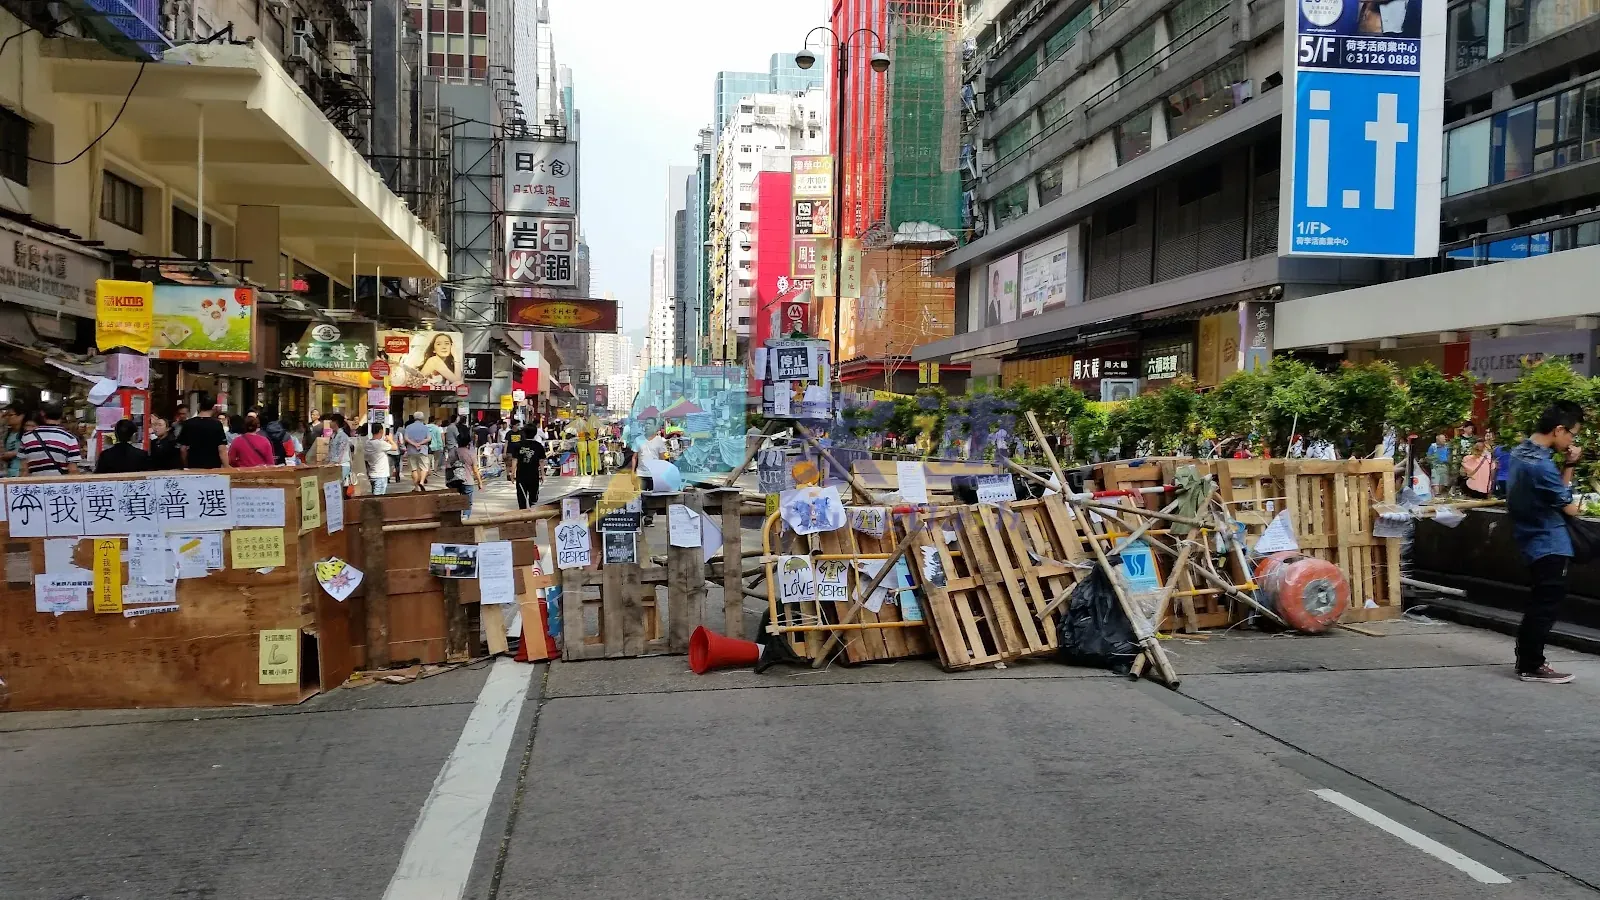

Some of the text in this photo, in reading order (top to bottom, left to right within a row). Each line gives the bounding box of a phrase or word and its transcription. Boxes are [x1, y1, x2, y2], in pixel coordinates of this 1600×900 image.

[1300, 36, 1336, 63] 5/F
[1345, 39, 1418, 54] 荷李活商業中心
[1356, 53, 1418, 65] 3126 0888
[1306, 89, 1409, 210] i.t
[512, 221, 570, 250] 岩石
[1297, 222, 1320, 235] 1/F
[1296, 236, 1349, 246] 荷李活商業中心
[511, 252, 571, 281] 火鍋
[114, 296, 144, 307] KMB
[280, 359, 300, 368] SENG
[780, 355, 807, 368] 停止
[1073, 357, 1100, 380] 周大福
[1104, 360, 1128, 369] 周大福
[1147, 354, 1178, 374] 六福珠寶
[50, 489, 229, 524] 我要真普選
[559, 550, 591, 565] RESPECT
[783, 582, 815, 598] LOVE
